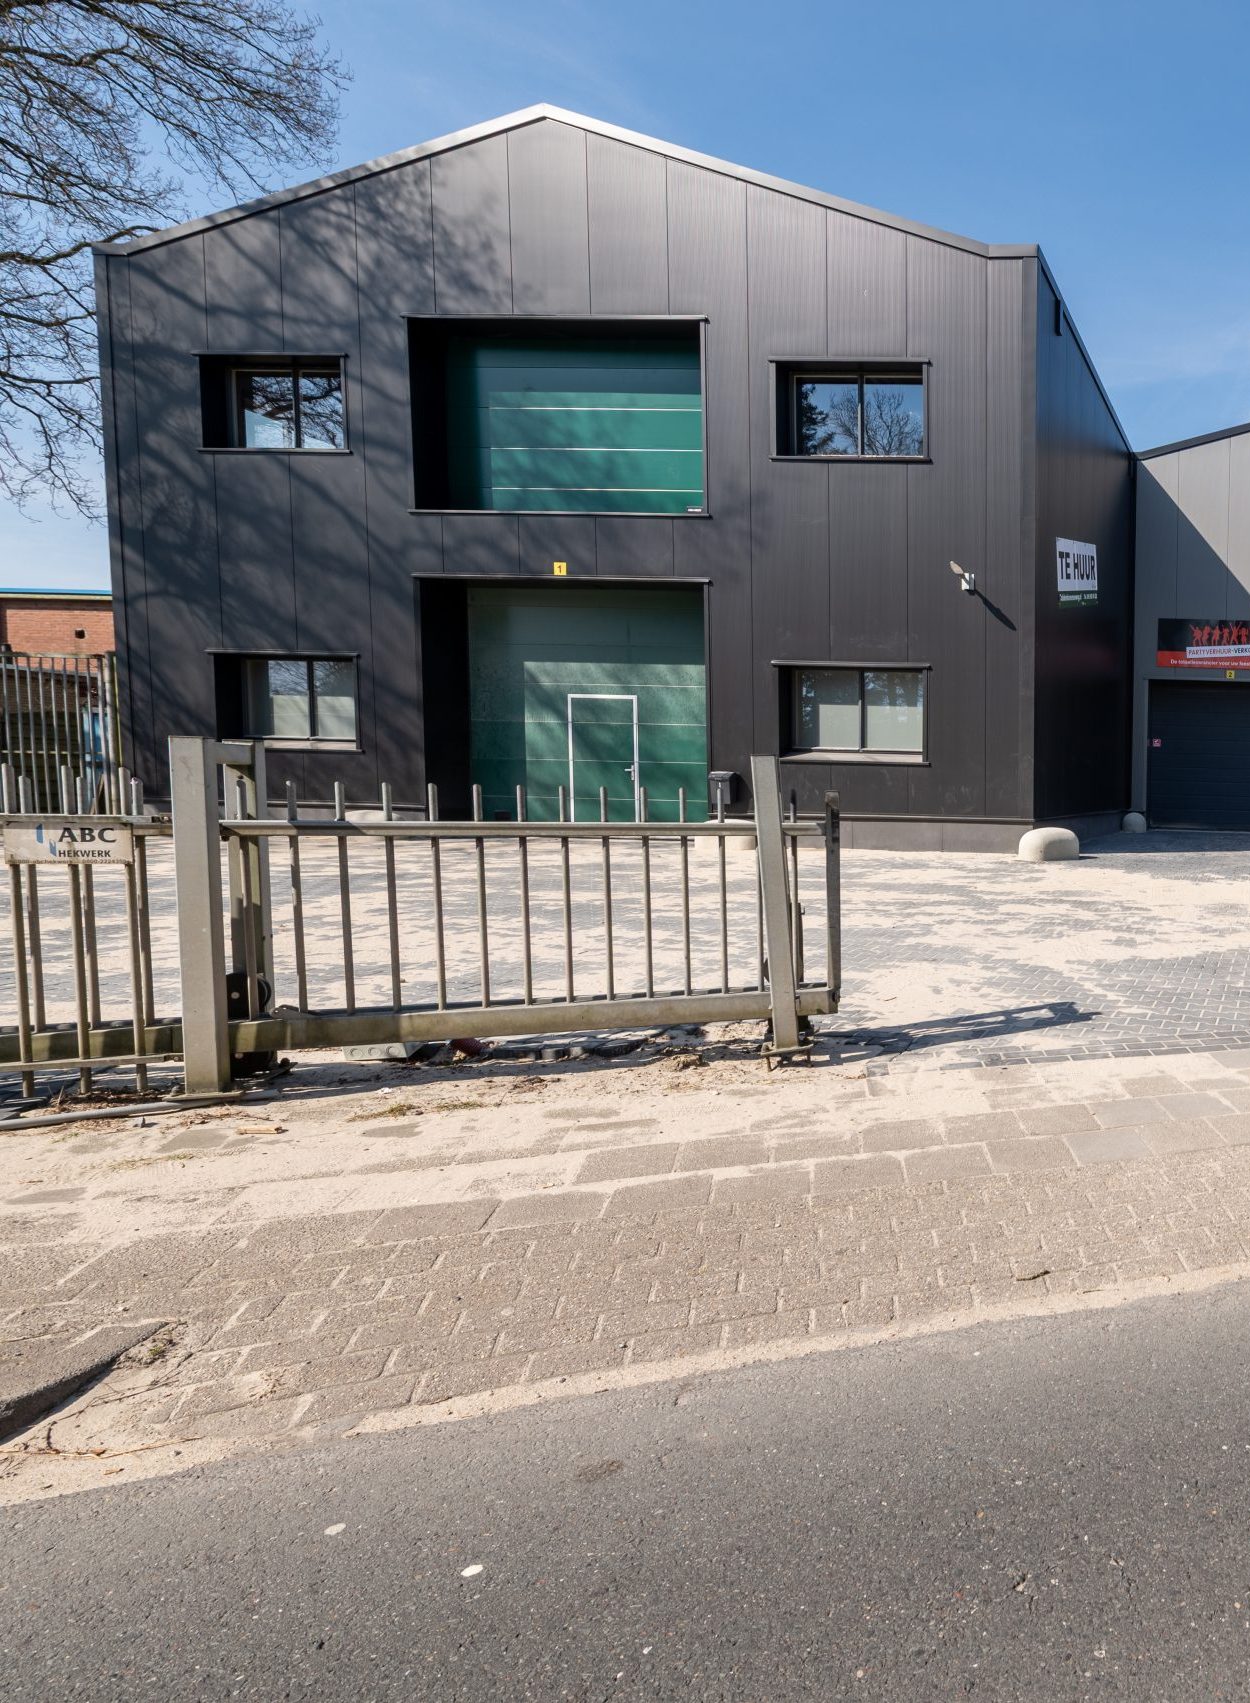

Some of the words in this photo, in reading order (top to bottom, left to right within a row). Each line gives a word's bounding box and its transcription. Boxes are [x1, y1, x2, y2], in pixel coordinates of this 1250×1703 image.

[1058, 551, 1071, 580] TE
[1073, 553, 1096, 580] HUUR
[58, 827, 117, 843] ABC
[58, 849, 111, 858] HEKWERK
